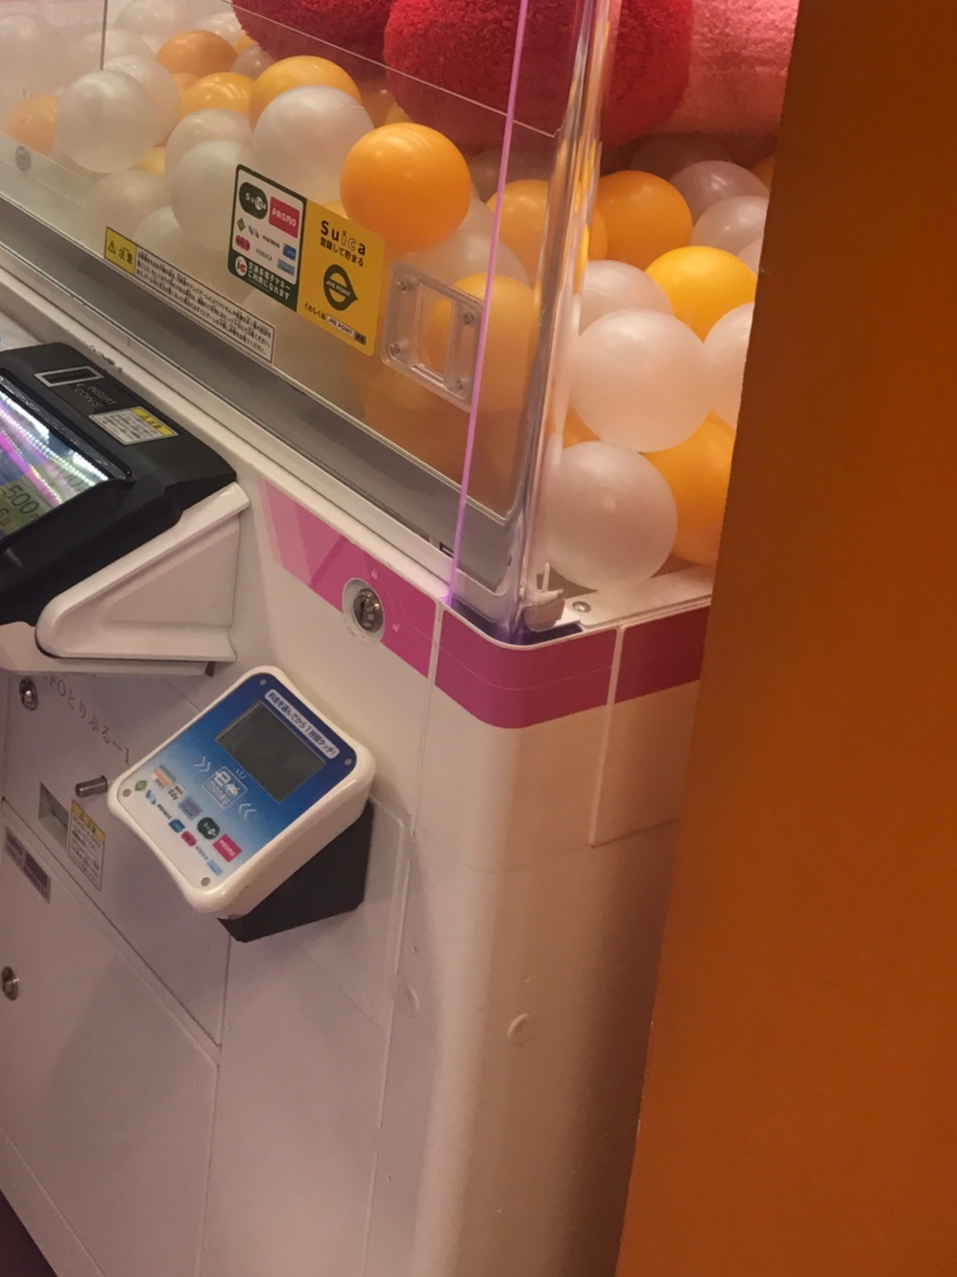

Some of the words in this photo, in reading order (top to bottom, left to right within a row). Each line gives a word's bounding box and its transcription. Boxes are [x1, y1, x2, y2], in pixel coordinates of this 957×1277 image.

[271, 207, 297, 228] PASMO
[320, 220, 367, 256] Suica
[205, 779, 231, 806] money
